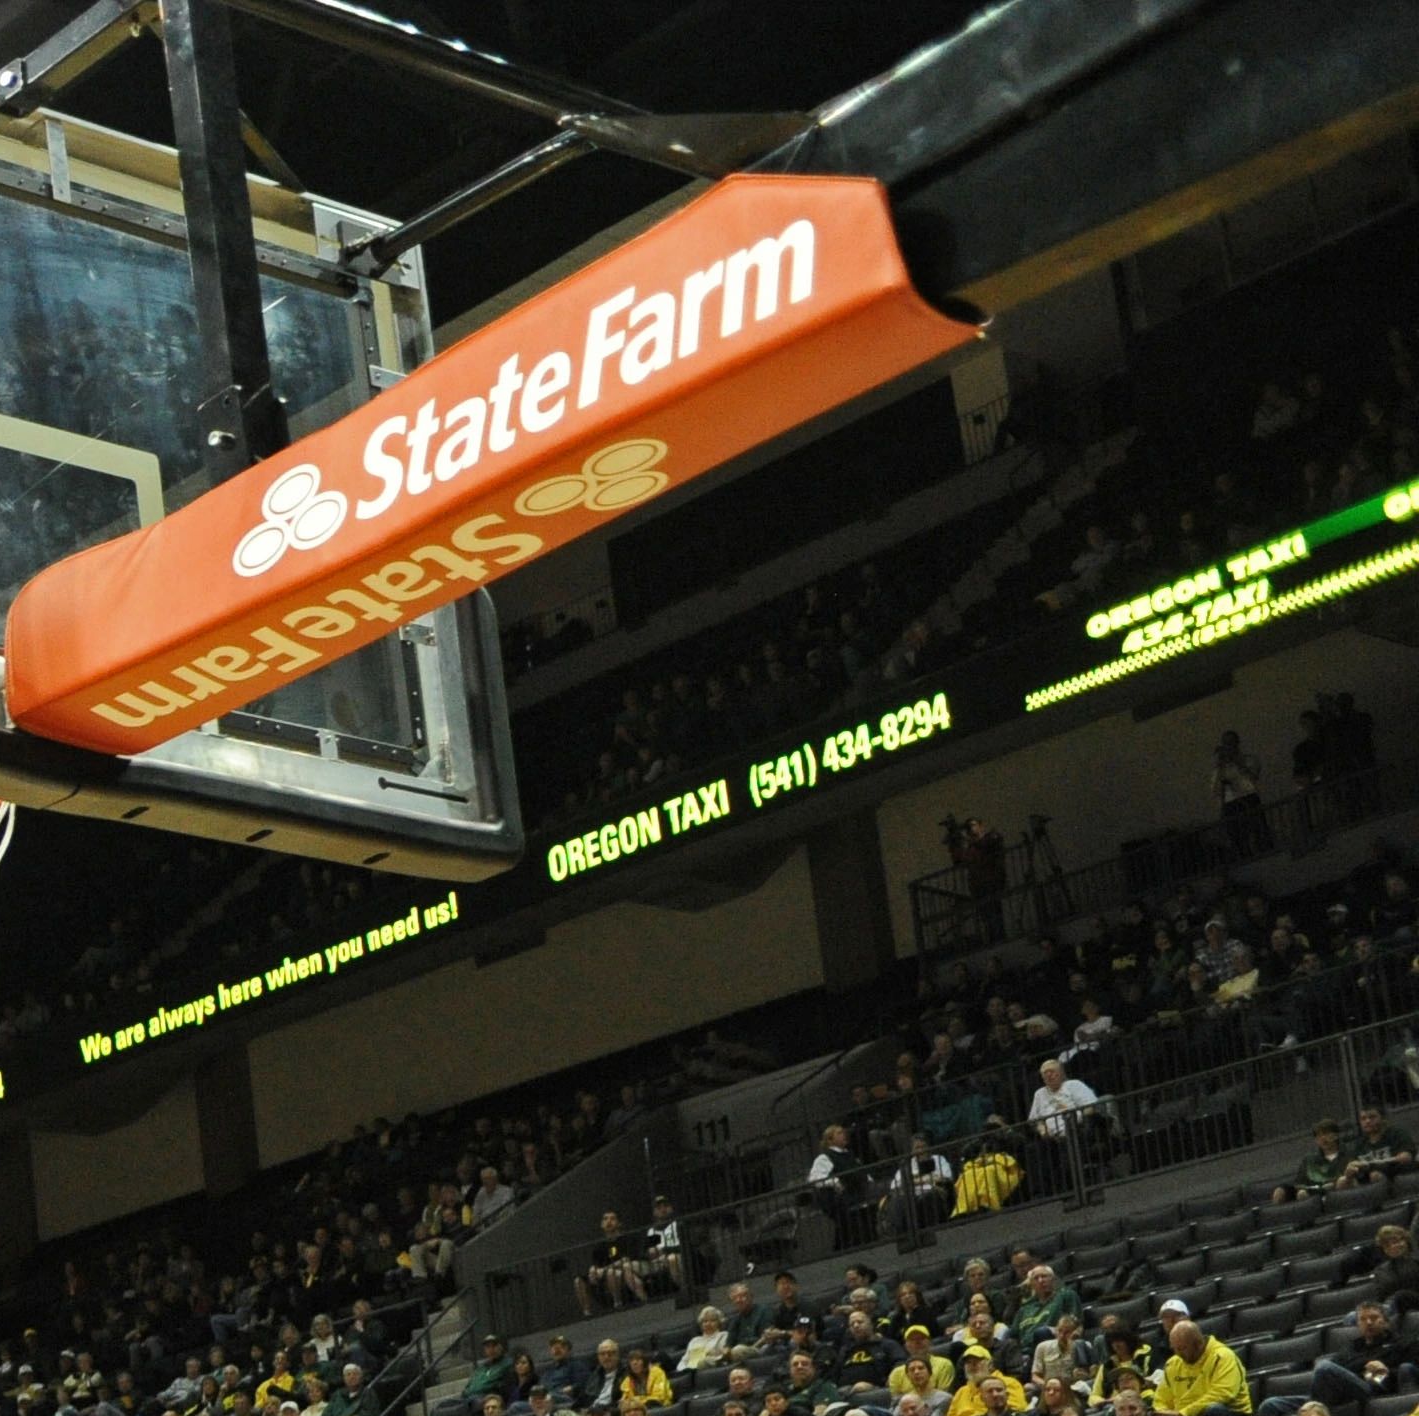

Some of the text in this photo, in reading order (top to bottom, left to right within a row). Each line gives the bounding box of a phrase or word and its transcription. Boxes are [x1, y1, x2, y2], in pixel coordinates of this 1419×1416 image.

[1086, 529, 1310, 639] OREGON TAXI
[1121, 578, 1270, 653] 434-TAXI
[547, 692, 951, 882] OREGON TAXI (541) 434-8294
[79, 891, 459, 1064] We are always here when you need us!
